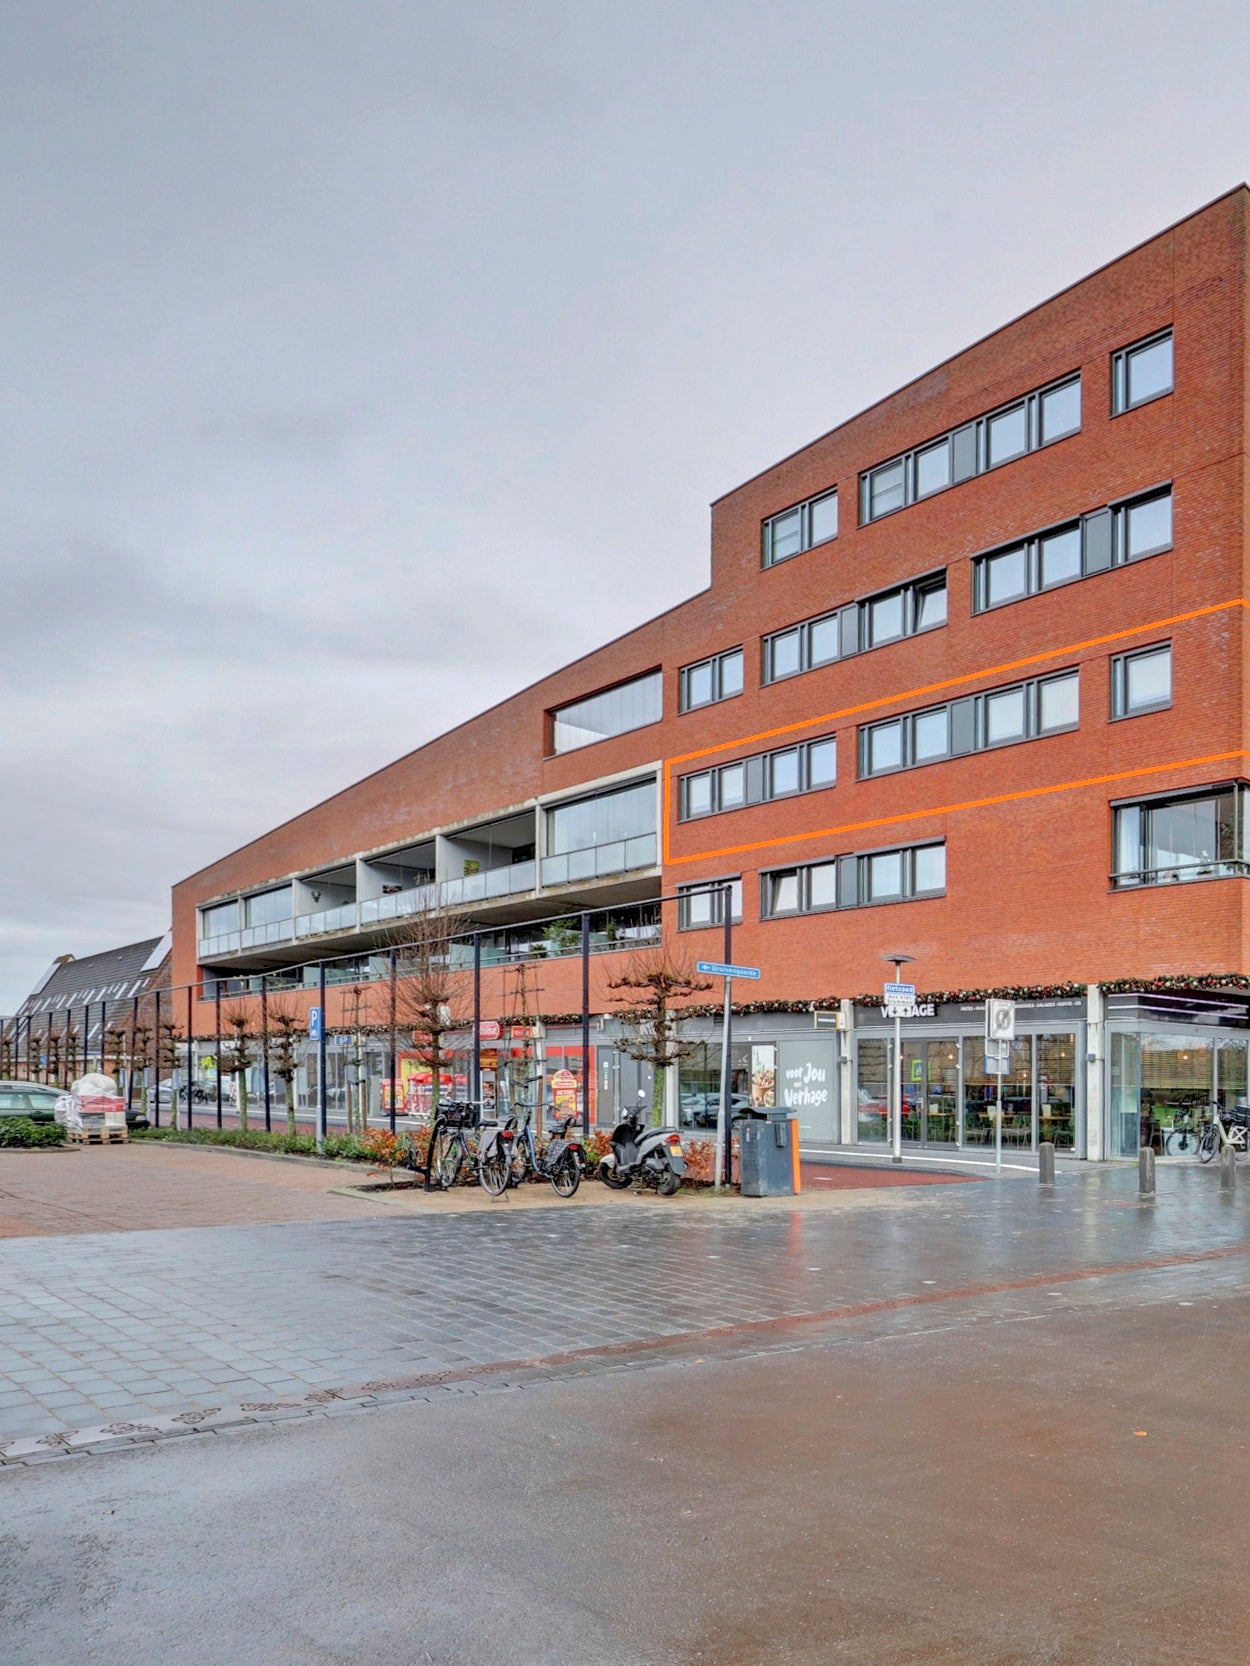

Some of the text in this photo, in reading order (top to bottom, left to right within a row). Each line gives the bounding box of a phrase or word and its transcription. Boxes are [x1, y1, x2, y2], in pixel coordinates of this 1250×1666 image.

[886, 985, 914, 994] fietspad
[881, 1004, 935, 1019] VAGE
[786, 1062, 826, 1083] voor Jou
[784, 1087, 828, 1107] Verhage
